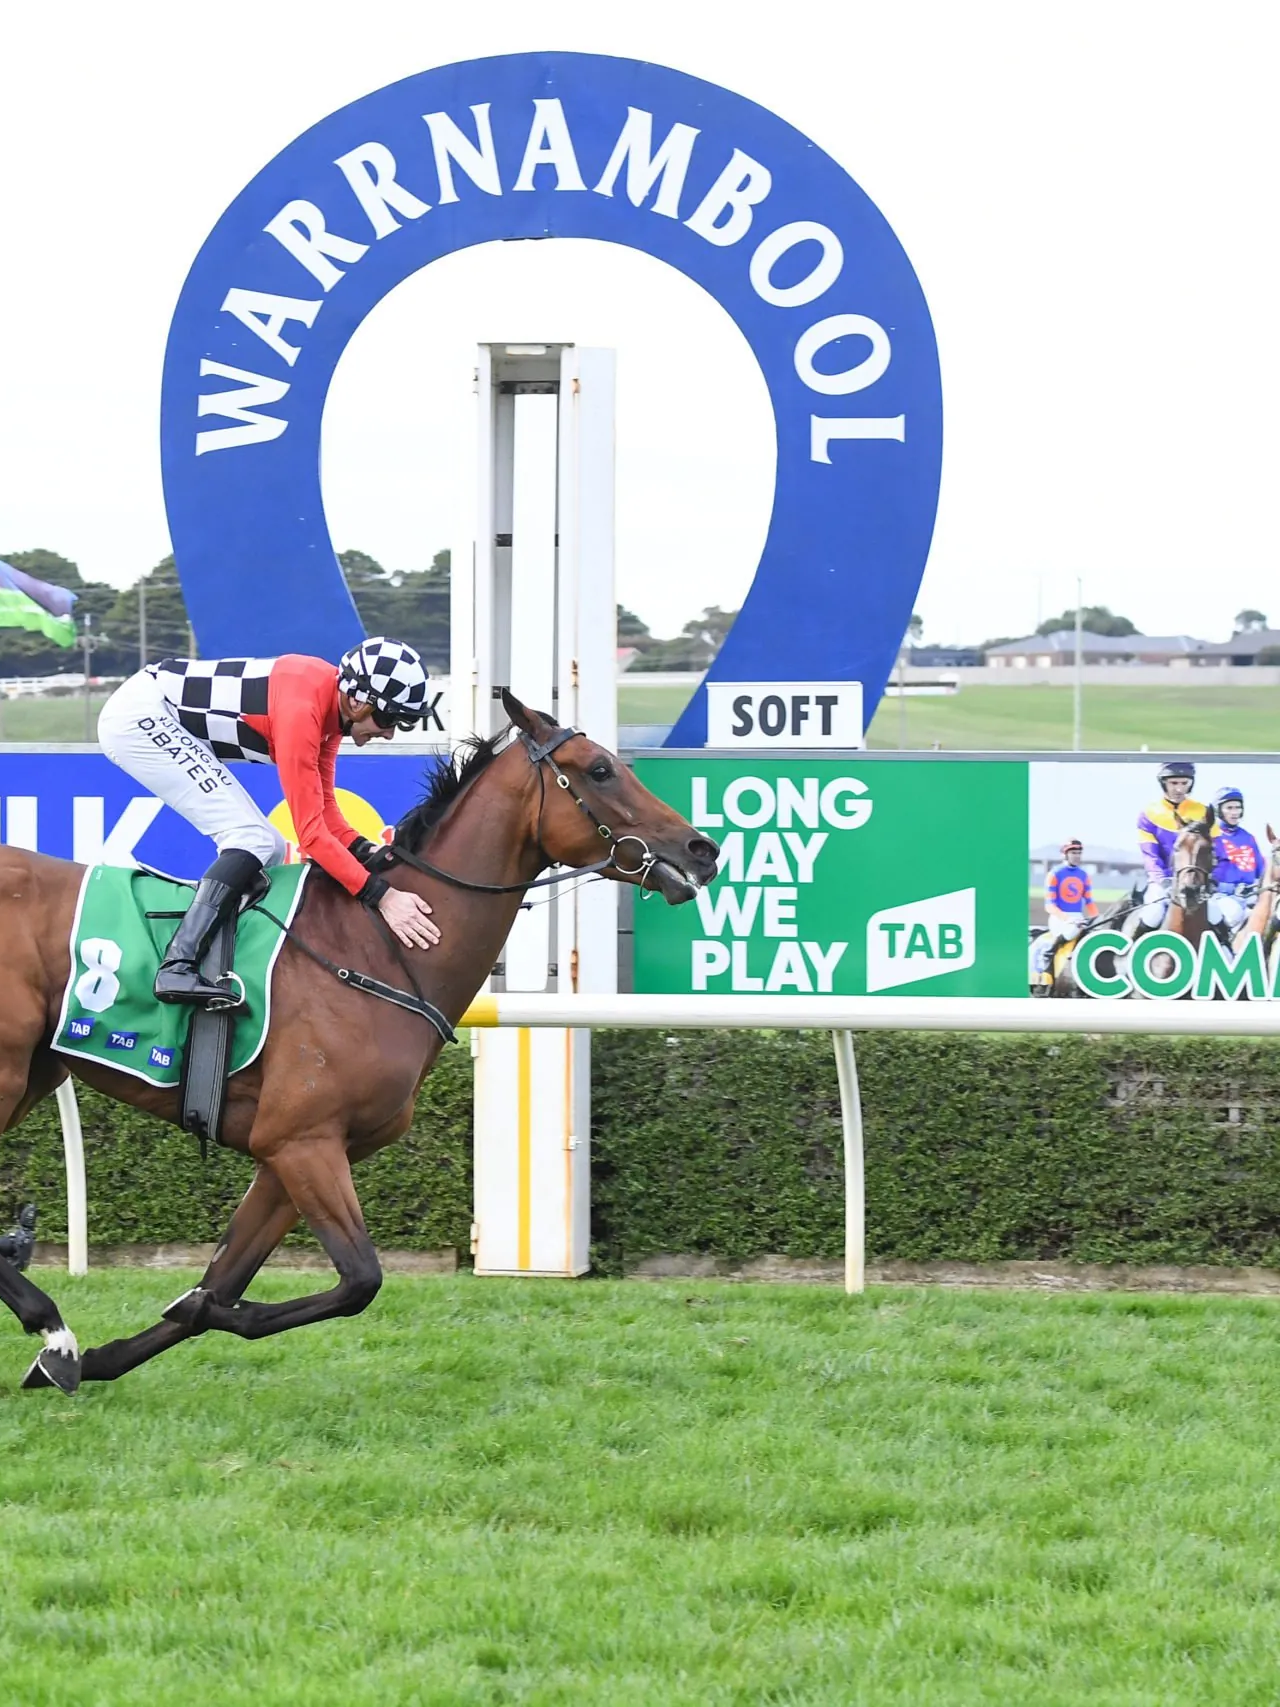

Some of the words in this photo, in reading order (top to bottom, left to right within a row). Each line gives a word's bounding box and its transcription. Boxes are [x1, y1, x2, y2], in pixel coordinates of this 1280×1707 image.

[195, 97, 906, 465] WARRNAMBOOL
[731, 694, 839, 737] SOFT
[137, 716, 219, 794] D.BATES
[691, 776, 873, 830] LONG
[698, 831, 830, 884] MAY
[695, 886, 798, 938] WE
[691, 940, 850, 993] PLAY
[879, 923, 963, 959] TAB
[1072, 929, 1280, 1000] COM
[74, 937, 123, 1013] 8
[71, 1021, 91, 1036] TAB
[111, 1033, 135, 1048] TAB
[151, 1048, 170, 1067] TAB
